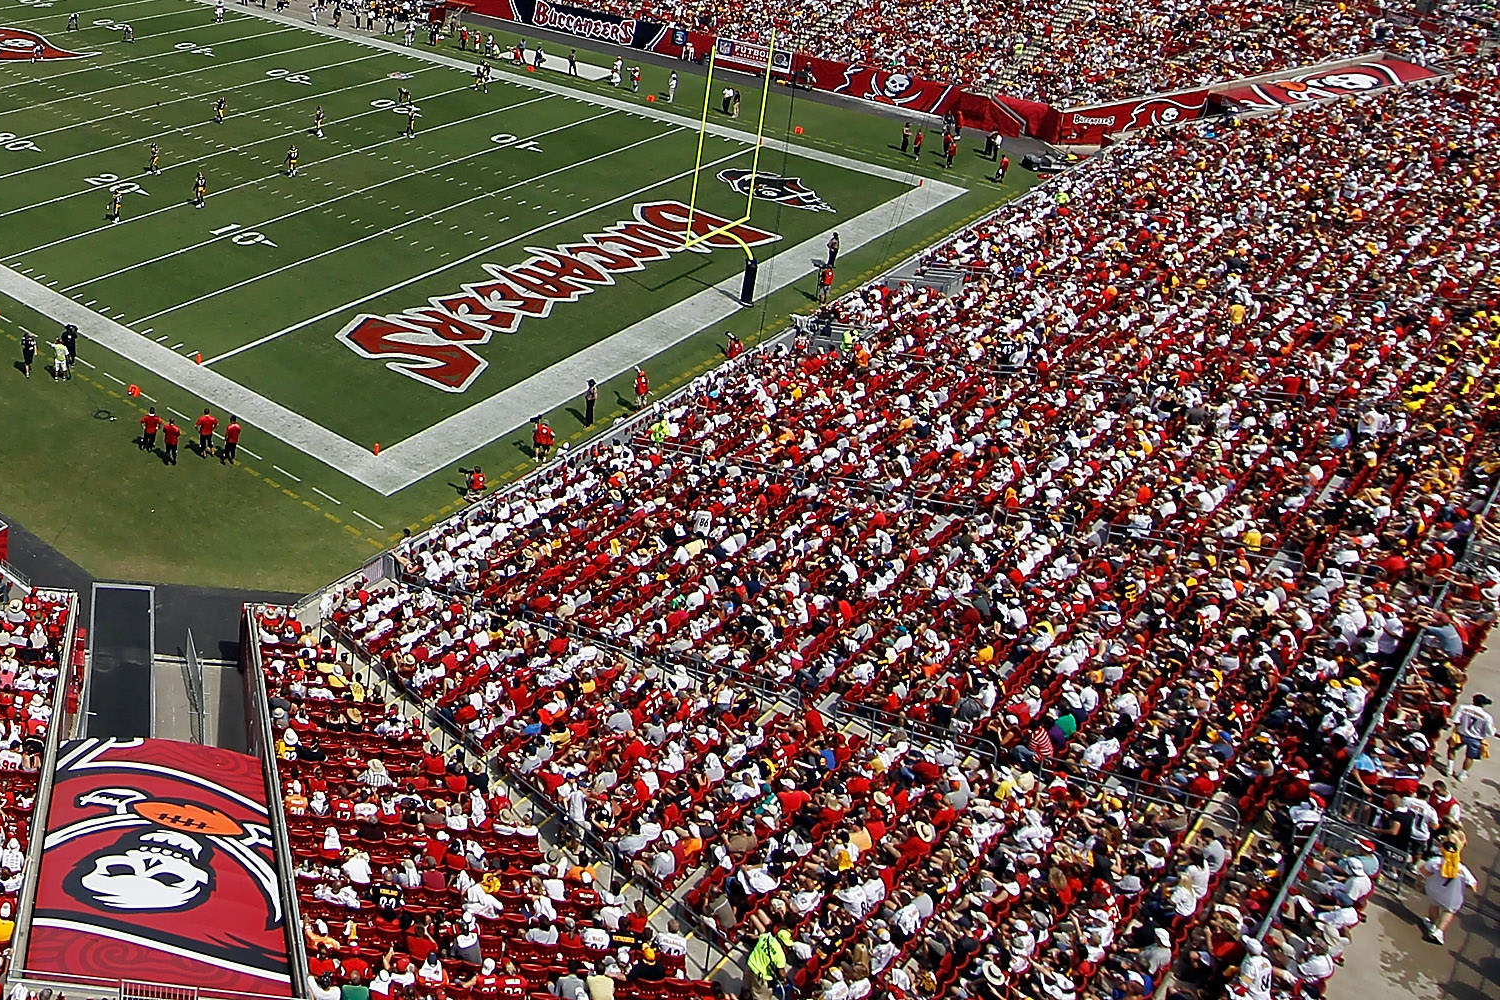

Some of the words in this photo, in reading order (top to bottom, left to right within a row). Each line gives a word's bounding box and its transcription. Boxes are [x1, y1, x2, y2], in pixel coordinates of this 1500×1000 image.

[84, 173, 141, 194] 20
[209, 223, 266, 246] 10
[334, 200, 782, 393] BUCCANEERS
[699, 518, 708, 528] 86
